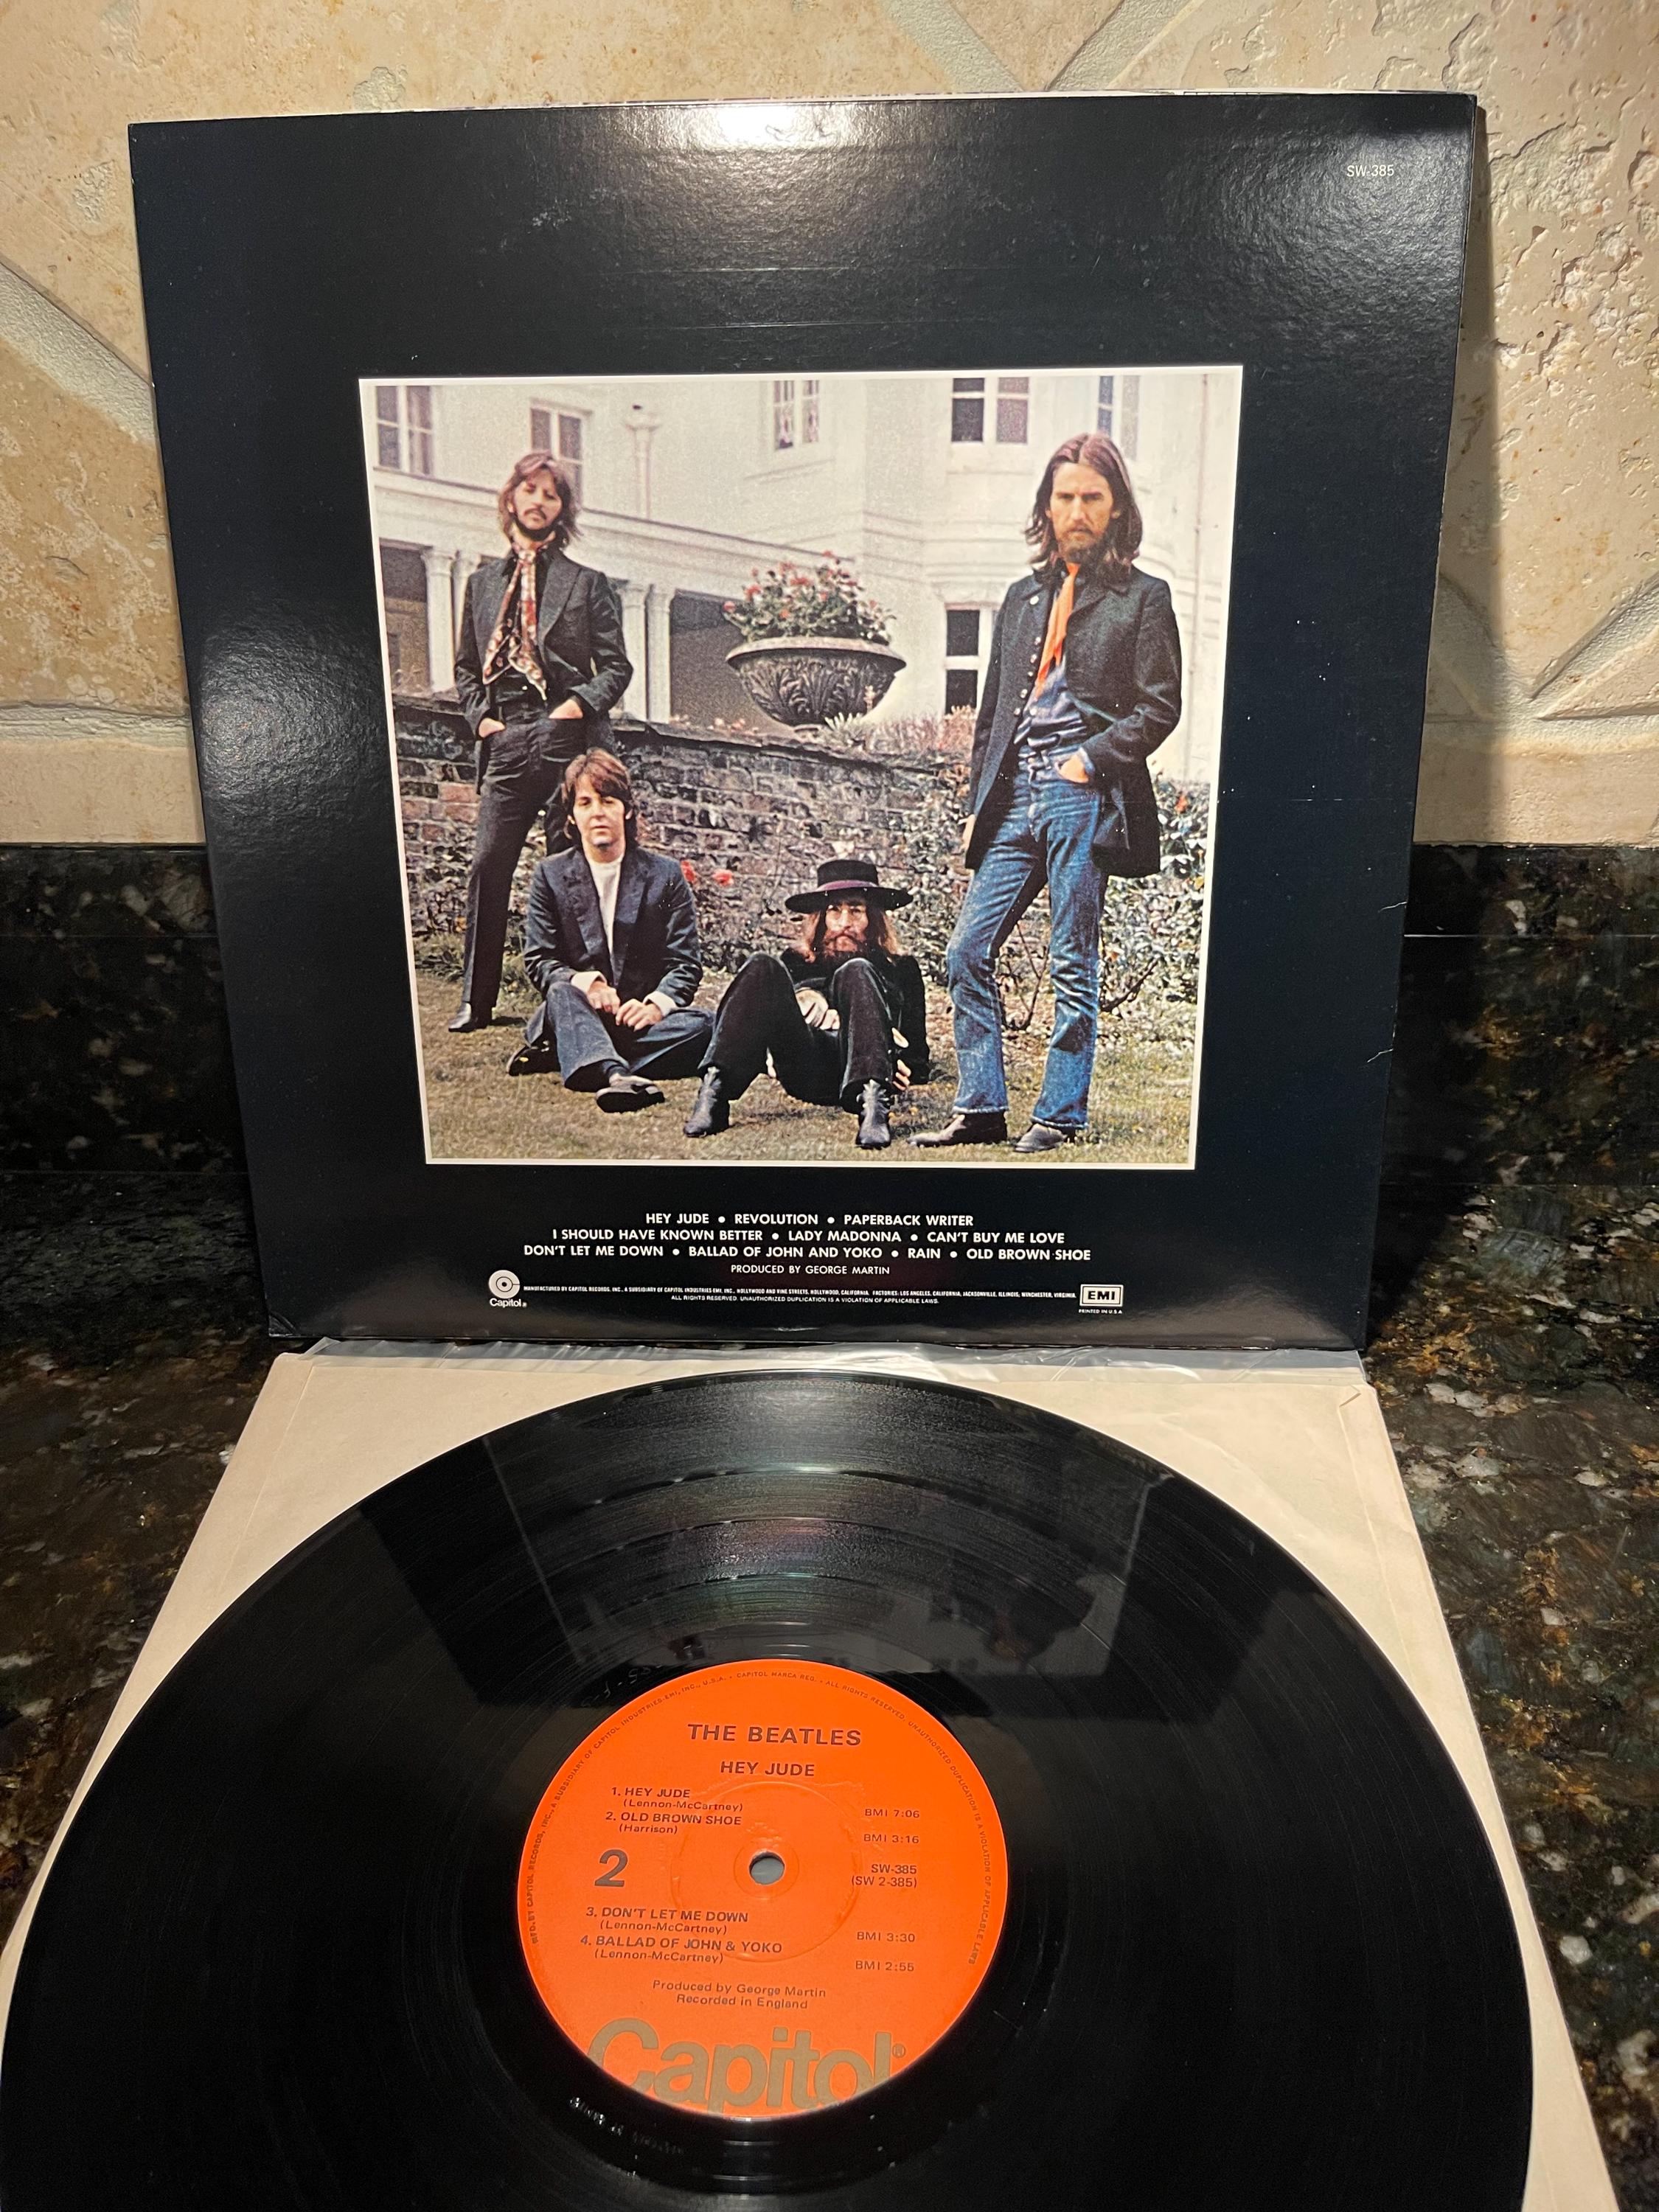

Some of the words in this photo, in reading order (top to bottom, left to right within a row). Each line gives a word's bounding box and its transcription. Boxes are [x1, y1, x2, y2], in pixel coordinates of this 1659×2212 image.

[647, 1214, 671, 1223] HEY
[677, 1214, 709, 1223] JUDE
[735, 1214, 818, 1224] REVOLUTION
[844, 1215, 920, 1225] PAPERBACK
[926, 1215, 973, 1225] WRITER
[553, 1229, 557, 1239] I
[562, 1229, 613, 1239] SHOULD
[619, 1230, 655, 1239] HAVE
[661, 1230, 714, 1239] KNOWN
[720, 1231, 762, 1240] BETTER
[789, 1231, 822, 1241] LADY
[828, 1231, 901, 1242] MADONNA
[928, 1232, 968, 1242] CAN'T
[973, 1233, 1000, 1243] BUY
[1005, 1233, 1024, 1243] ME
[1030, 1233, 1064, 1243] LOVE
[524, 1245, 566, 1255] DON'T
[571, 1246, 590, 1256] LET
[596, 1246, 614, 1256] ME
[620, 1246, 663, 1256] DOWN
[689, 1246, 738, 1256] BALLAD
[743, 1247, 760, 1256] OF
[766, 1247, 803, 1257] JOHN
[809, 1247, 838, 1257] AND
[843, 1248, 882, 1258] YOKO
[908, 1248, 940, 1259] RAIN
[967, 1248, 993, 1259] OLD
[998, 1249, 1050, 1260] BROWN
[1055, 1250, 1091, 1260] SHOE
[731, 1265, 784, 1273] PRODUCED
[789, 1265, 801, 1273] BY
[805, 1265, 846, 1274] GEORGE
[1088, 1290, 1115, 1300] EMI
[490, 1298, 521, 1307] Capitol
[688, 1724, 737, 1741] THE
[748, 1727, 860, 1746] BEATLES
[554, 1760, 585, 1801] SUBSIDIARY
[584, 1750, 593, 1759] OF
[594, 1727, 620, 1749] CAPITOL
[720, 1761, 759, 1774] HEY
[765, 1763, 814, 1776] JUDE
[826, 1680, 839, 1688] ALL
[842, 1685, 869, 1699] RIGHTS
[908, 1721, 951, 1764] UNAUTHORIZED
[950, 1766, 978, 1811] DUPLICATION
[979, 1831, 990, 1872] VIOLATION
[985, 1876, 991, 1886] OF
[612, 1787, 620, 1796] 1.
[625, 1788, 652, 1796] HEY
[657, 1789, 690, 1798] JUDE
[624, 1799, 742, 1812] (Lennon-McCartney)
[605, 1812, 616, 1820] 2.
[621, 1812, 648, 1821] OLD
[653, 1814, 701, 1823] BROWN
[706, 1816, 741, 1825] SHOE
[865, 1809, 887, 1817] BMI
[619, 1824, 678, 1834] (Harrison)
[892, 1835, 919, 1843] 3:16
[595, 1849, 627, 1887] 2
[872, 1864, 917, 1874] SW-385
[852, 1876, 874, 1885] (SW
[879, 1877, 917, 1888] 2-385)
[586, 1907, 597, 1917] 3.
[602, 1907, 646, 1918] DON'T
[650, 1909, 677, 1919] LET
[681, 1910, 701, 1920] ME
[706, 1912, 748, 1922] DOWN
[600, 1920, 727, 1935] (Lennon-McCartney)
[580, 1935, 591, 1945] 4.
[596, 1935, 655, 1947] BALLAD
[660, 1938, 680, 1948] OF
[684, 1939, 721, 1950] JOHN
[726, 1941, 735, 1951] &
[741, 1941, 782, 1952] YOKO
[858, 1932, 880, 1941] BMI
[887, 1933, 915, 1942] 3:30
[594, 1949, 723, 1964] (Lennon-McCartney)
[856, 1961, 880, 1970] BMI
[886, 1962, 914, 1971] 2:55
[653, 1980, 712, 1992] Produced
[717, 1983, 731, 1994] by
[737, 1984, 781, 1995] George
[785, 1987, 826, 1997] Martin
[677, 1994, 736, 2005] Recorded
[741, 1997, 751, 2006] in
[757, 1997, 807, 2009] England
[588, 2017, 891, 2115] Capitol
